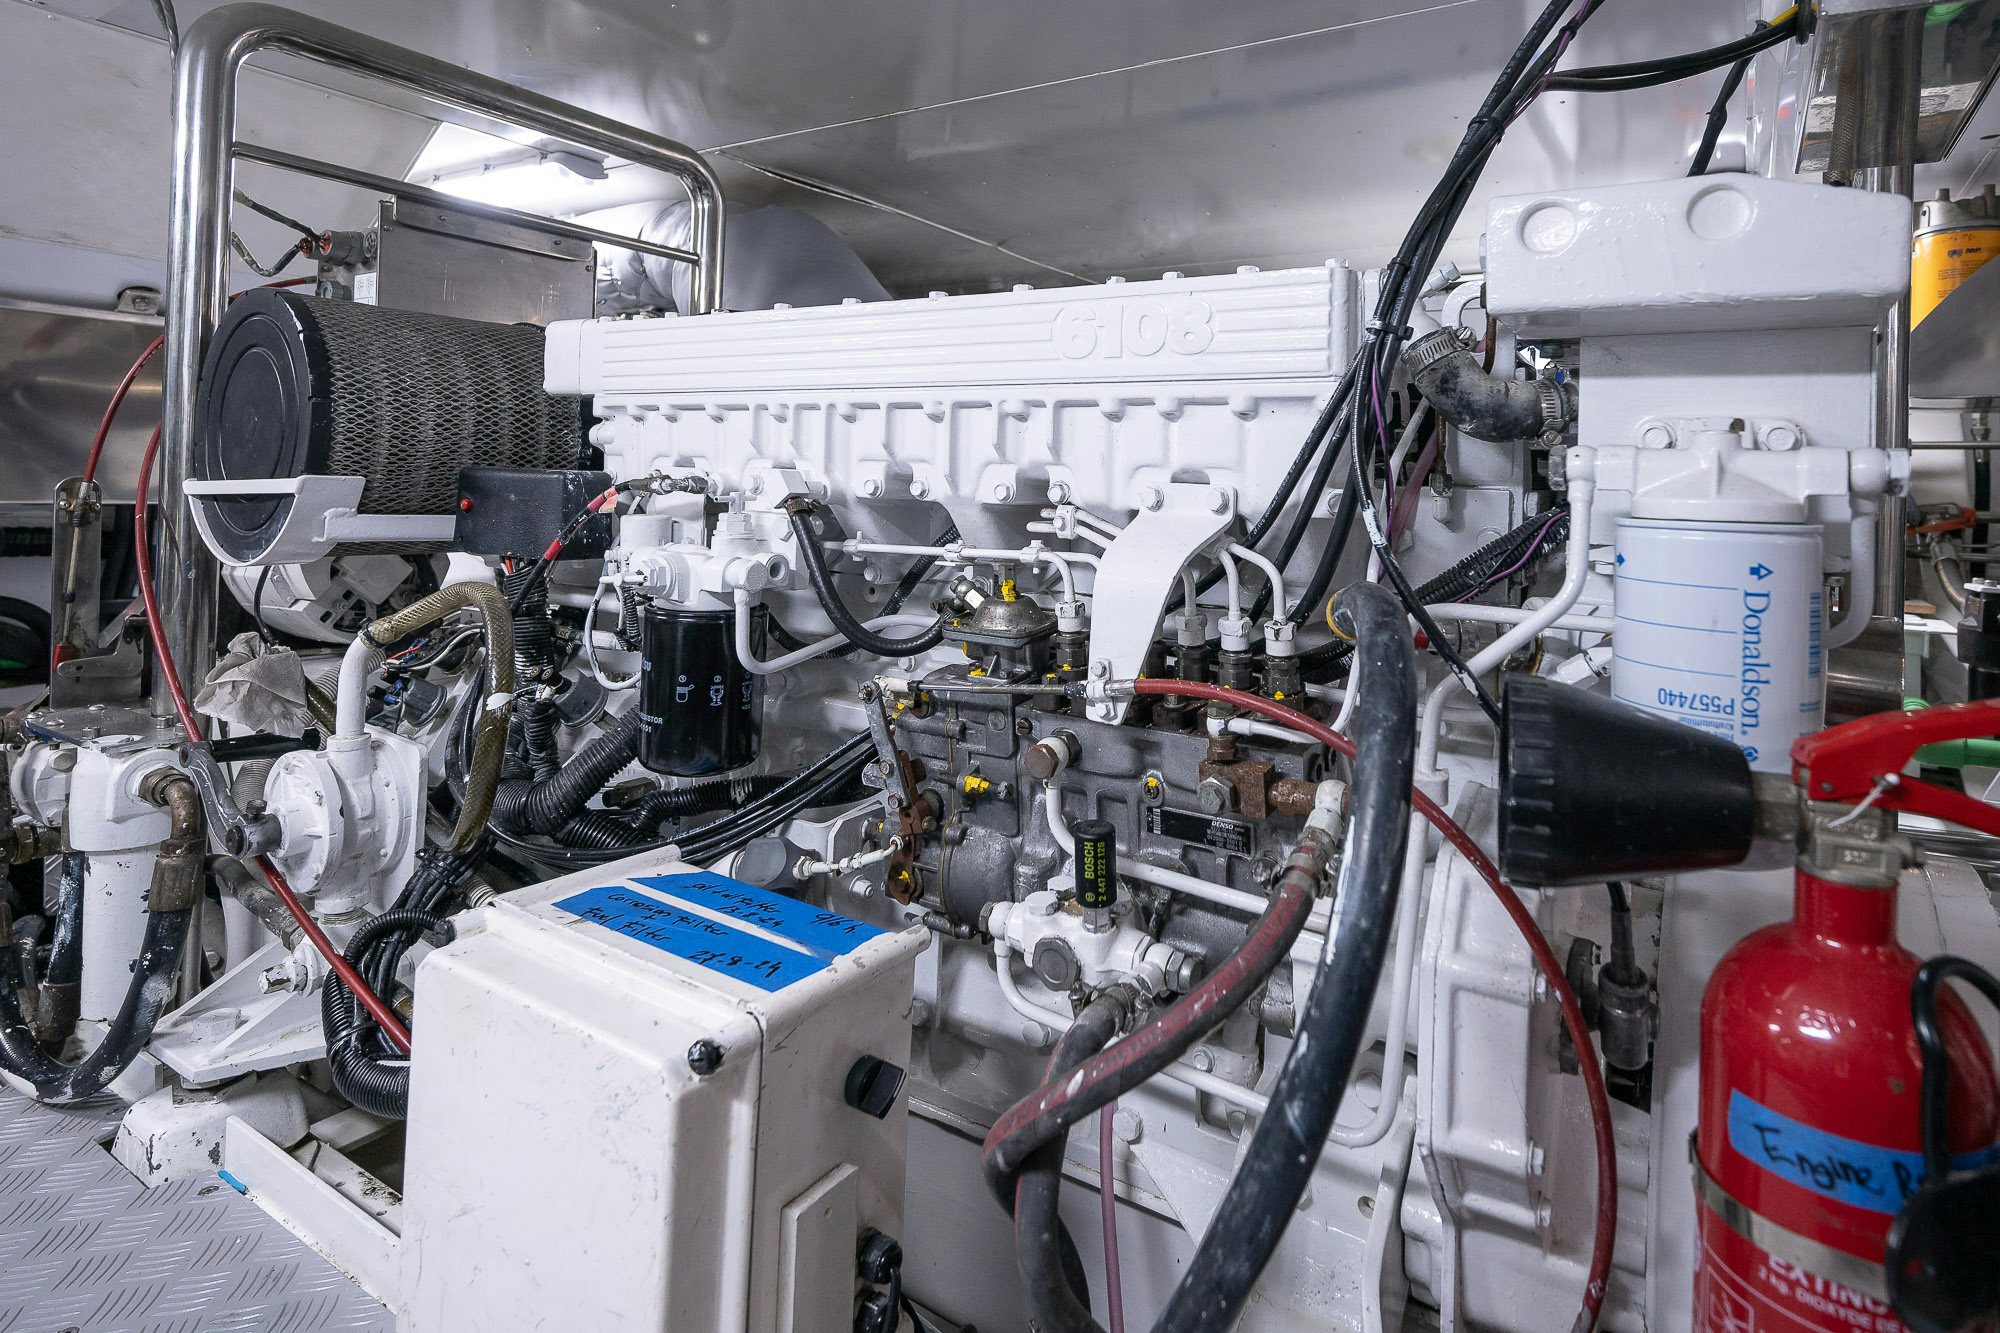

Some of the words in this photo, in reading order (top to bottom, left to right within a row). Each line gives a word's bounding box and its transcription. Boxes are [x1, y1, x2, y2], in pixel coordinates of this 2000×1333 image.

[1051, 297, 1214, 360] 6108
[1657, 687, 1735, 715] P557440
[1211, 820, 1234, 830] DENSO
[1084, 841, 1095, 879] BOSCH
[1097, 859, 1106, 876] 222
[1098, 878, 1106, 893] 447
[1752, 1122, 1885, 1196] Engine
[1891, 1160, 1926, 1200] R
